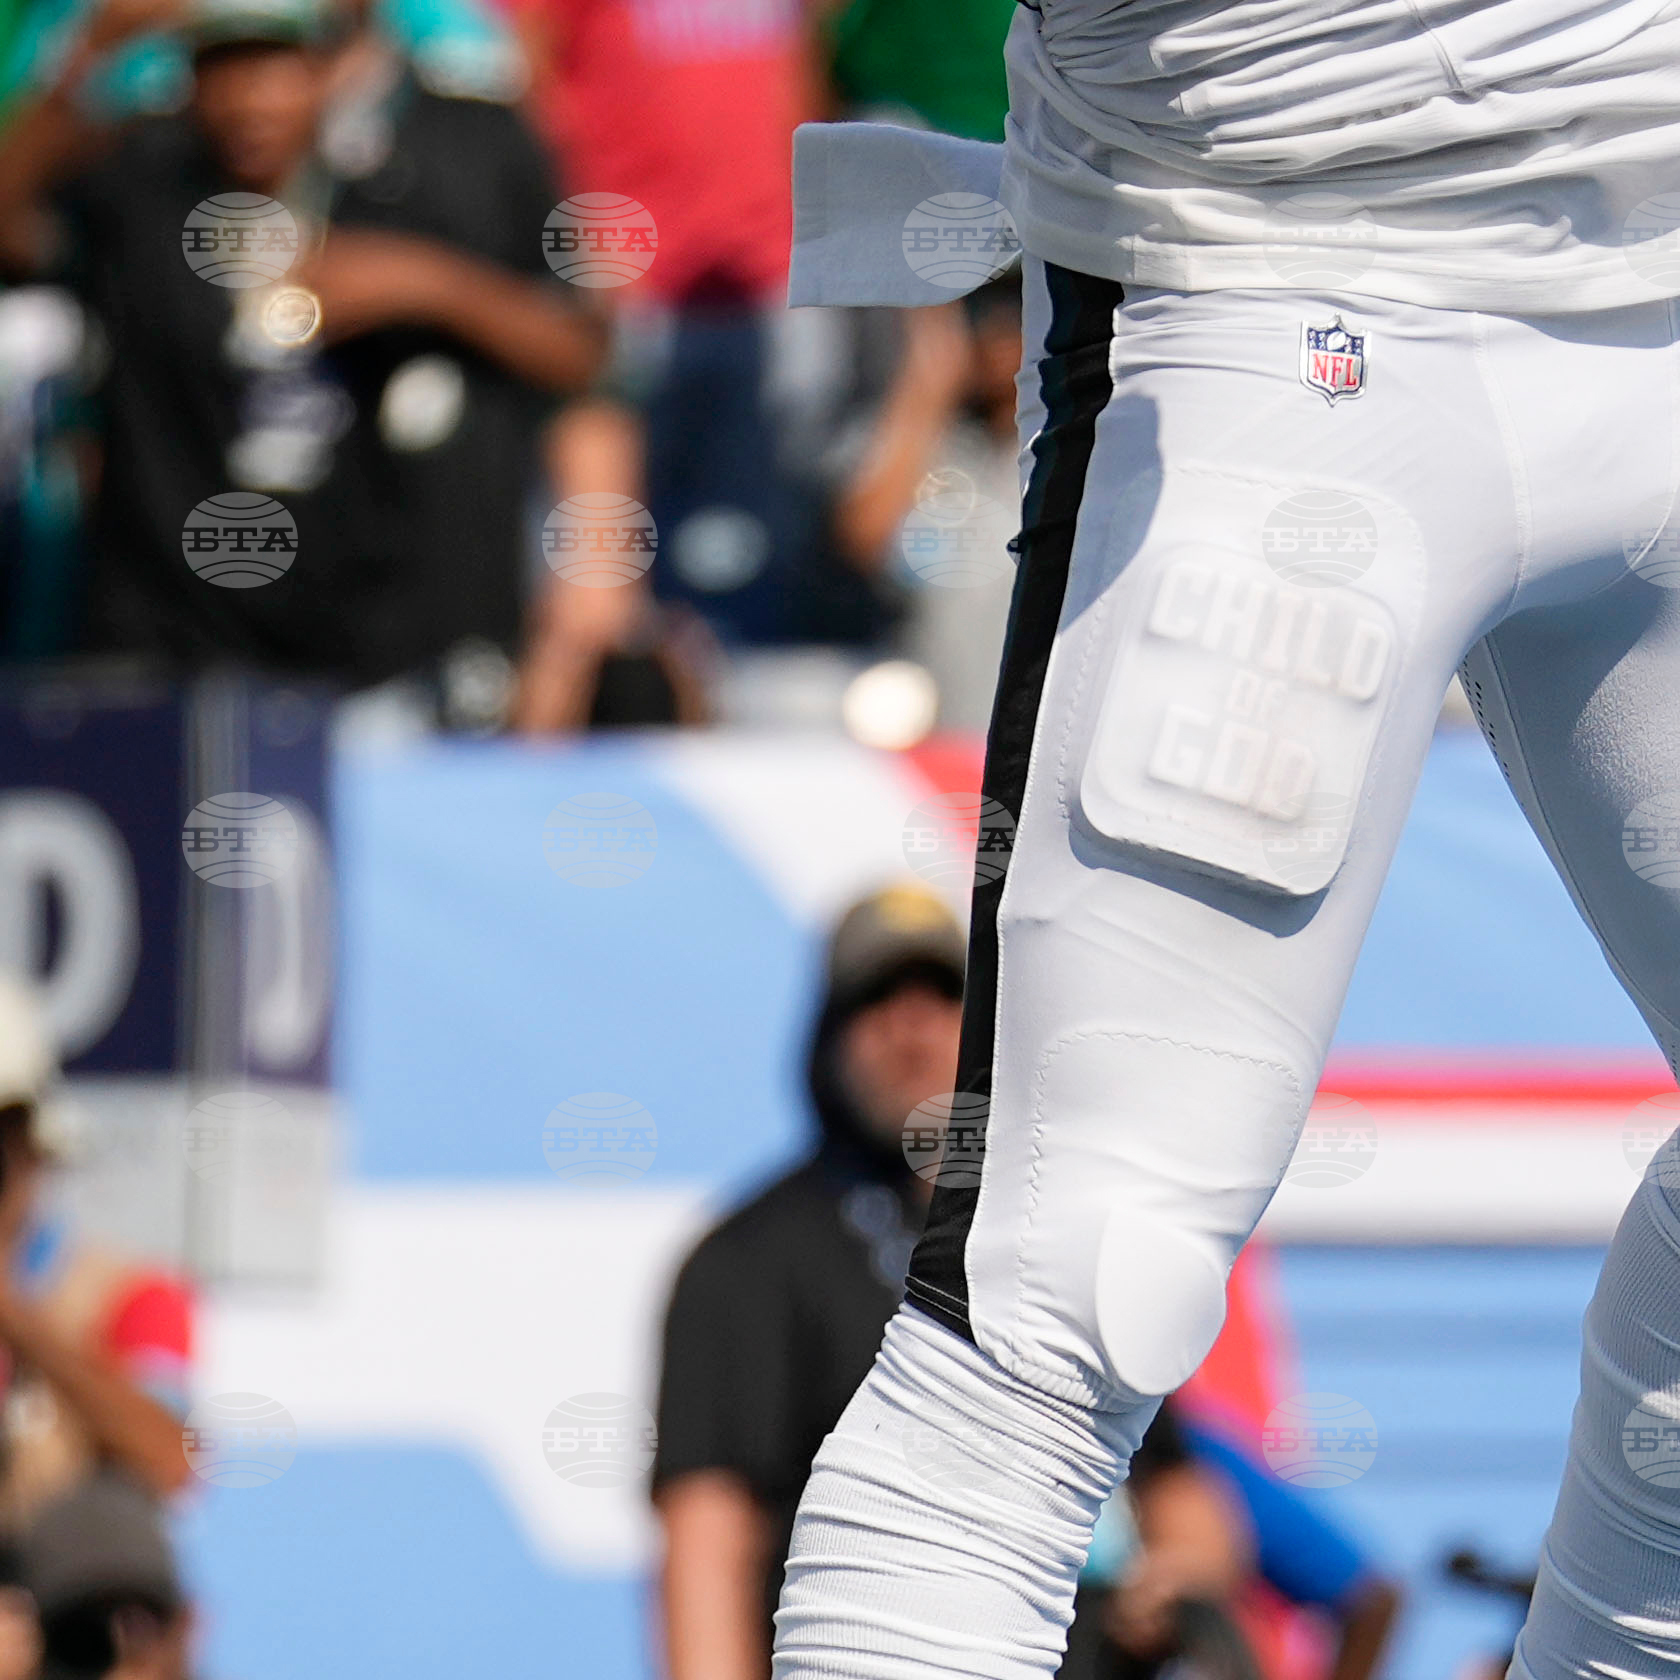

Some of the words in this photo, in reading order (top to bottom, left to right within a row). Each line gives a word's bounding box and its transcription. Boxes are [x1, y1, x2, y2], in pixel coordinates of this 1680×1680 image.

[1312, 353, 1358, 388] NFL
[1150, 562, 1392, 704] CHILD
[1150, 703, 1317, 822] GOD
